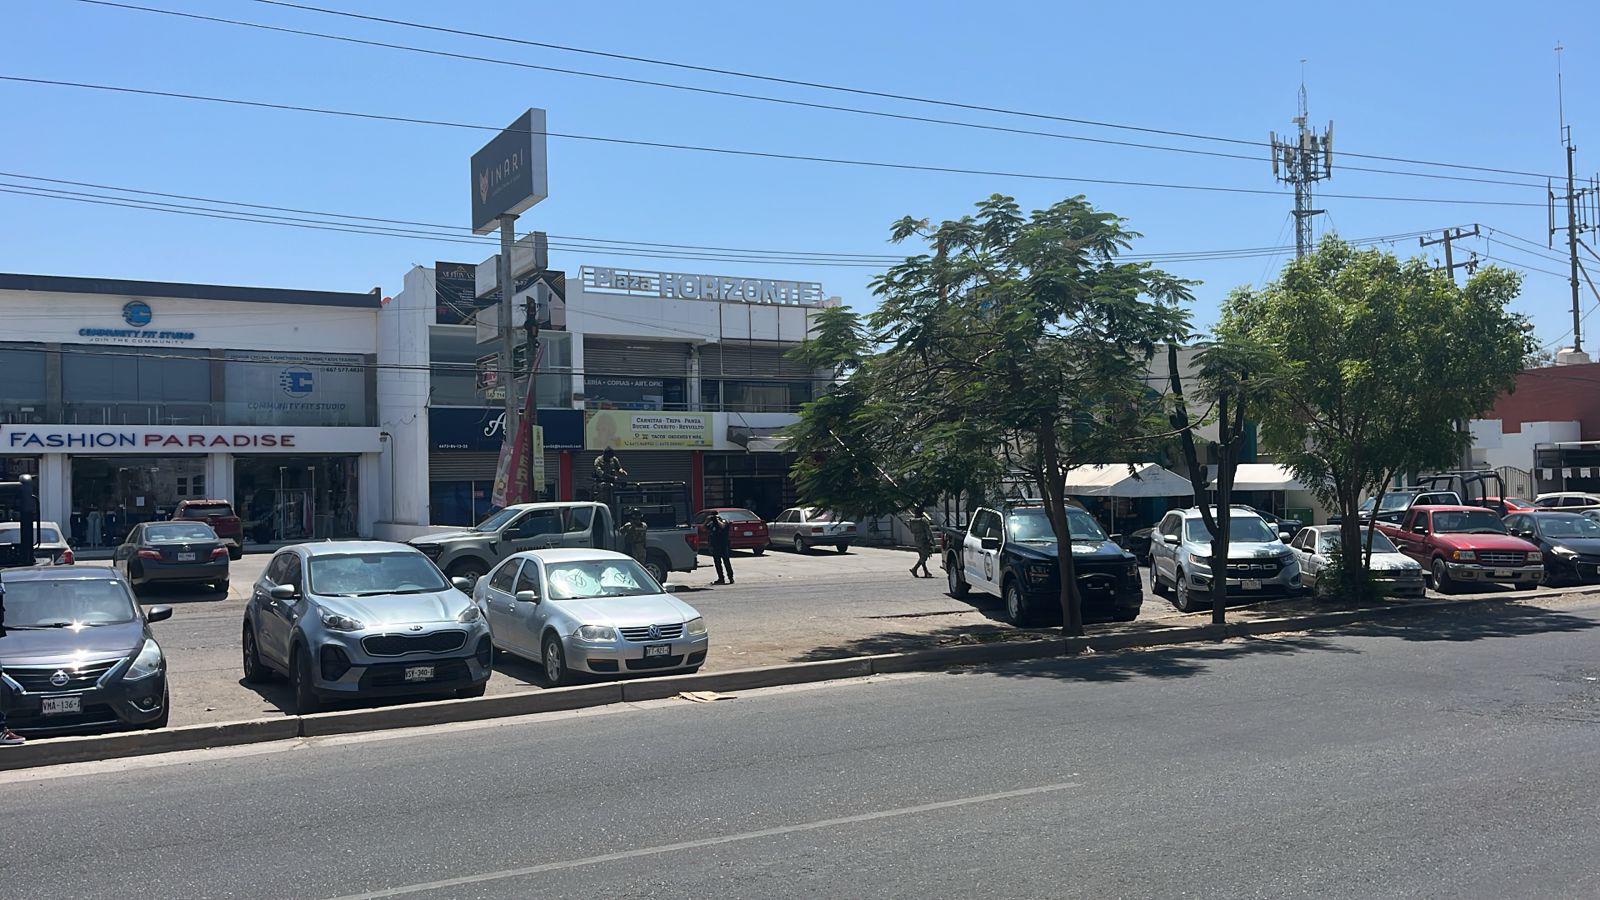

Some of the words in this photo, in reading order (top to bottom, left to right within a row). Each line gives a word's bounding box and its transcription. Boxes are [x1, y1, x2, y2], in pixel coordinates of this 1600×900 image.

[491, 148, 523, 187] INARI
[594, 267, 651, 290] Plaza
[660, 272, 822, 304] HORIZONTE
[79, 329, 139, 338] COMMUNITY
[142, 331, 157, 339] FIT
[159, 332, 194, 340] STUDIO
[247, 402, 299, 410] COMMUNITY
[10, 432, 136, 447] FASHION
[144, 434, 295, 447] PARADISE
[1226, 563, 1278, 571] FORD
